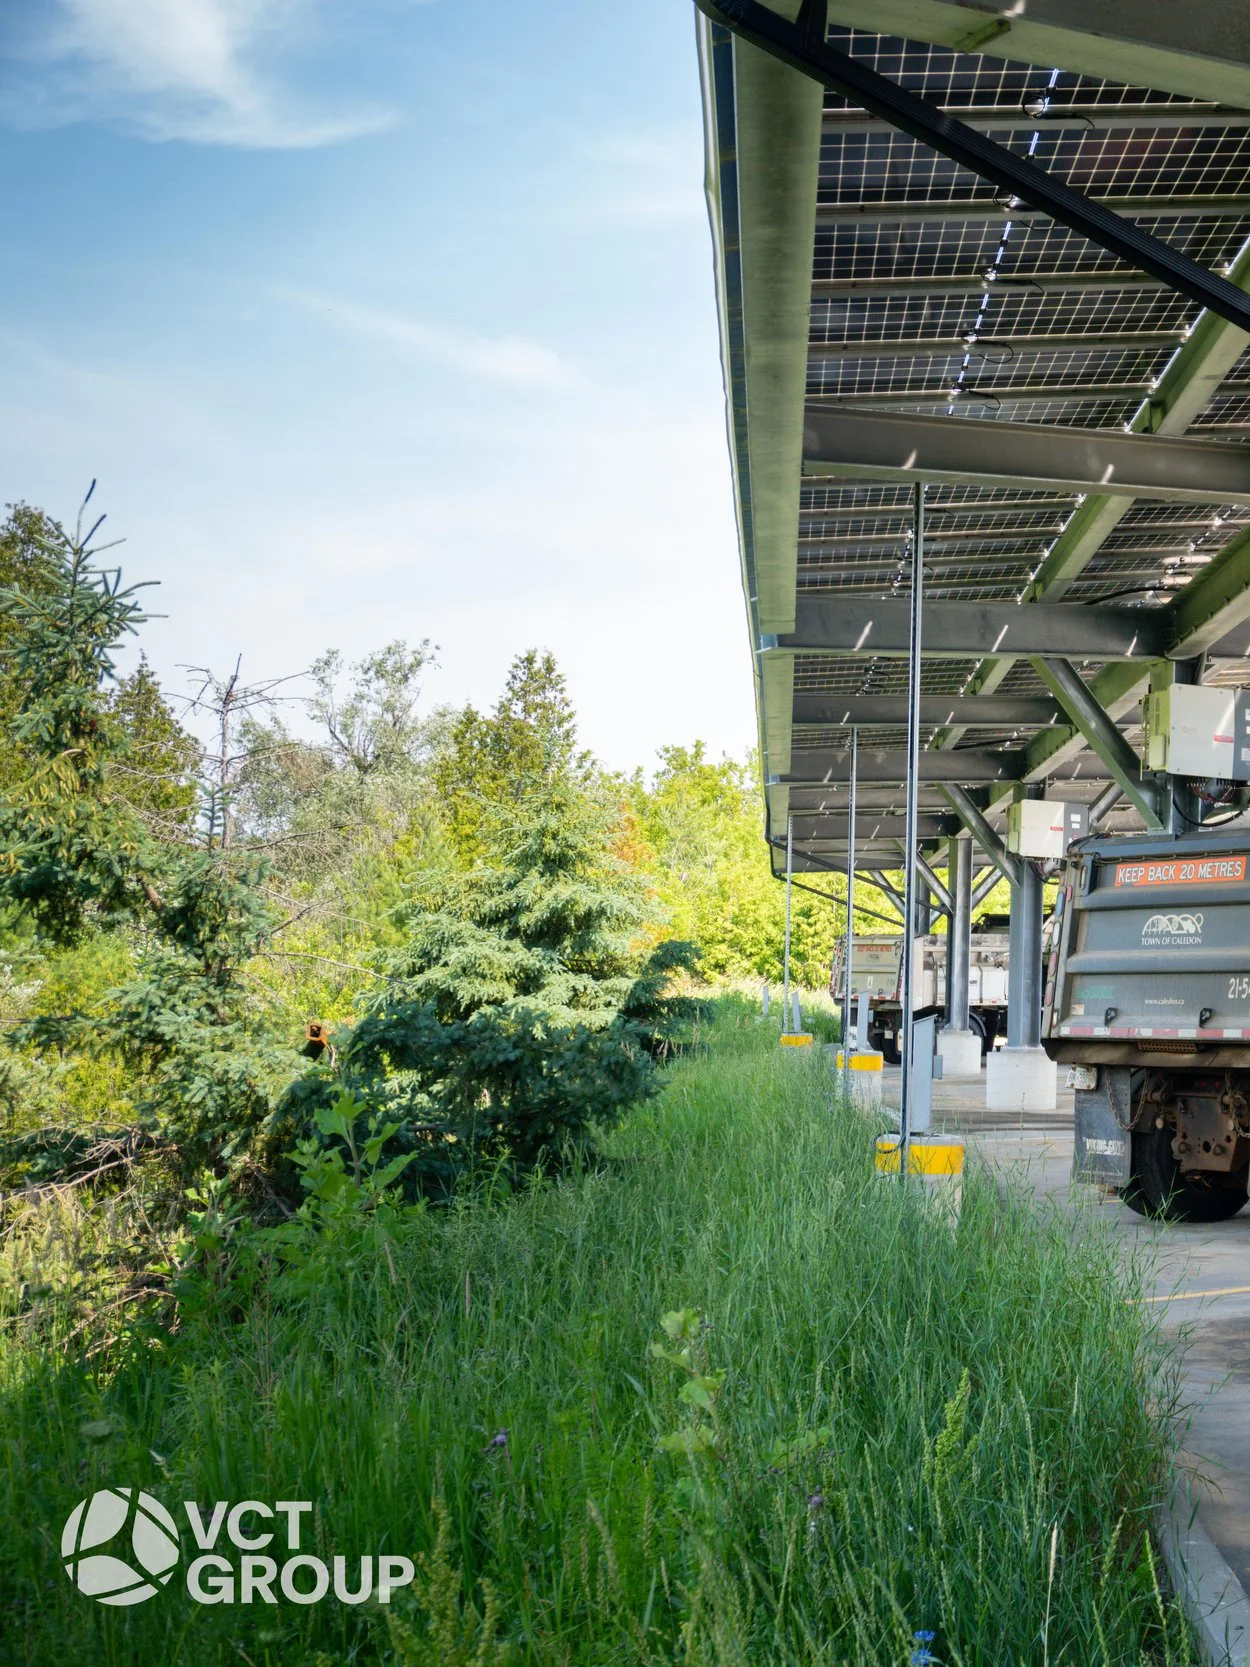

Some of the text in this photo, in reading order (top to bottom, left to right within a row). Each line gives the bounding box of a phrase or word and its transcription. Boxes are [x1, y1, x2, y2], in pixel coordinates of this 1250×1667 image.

[1118, 860, 1242, 883] KEEP BACK 20 METRES
[1141, 936, 1202, 946] TOWN OF CALEDON
